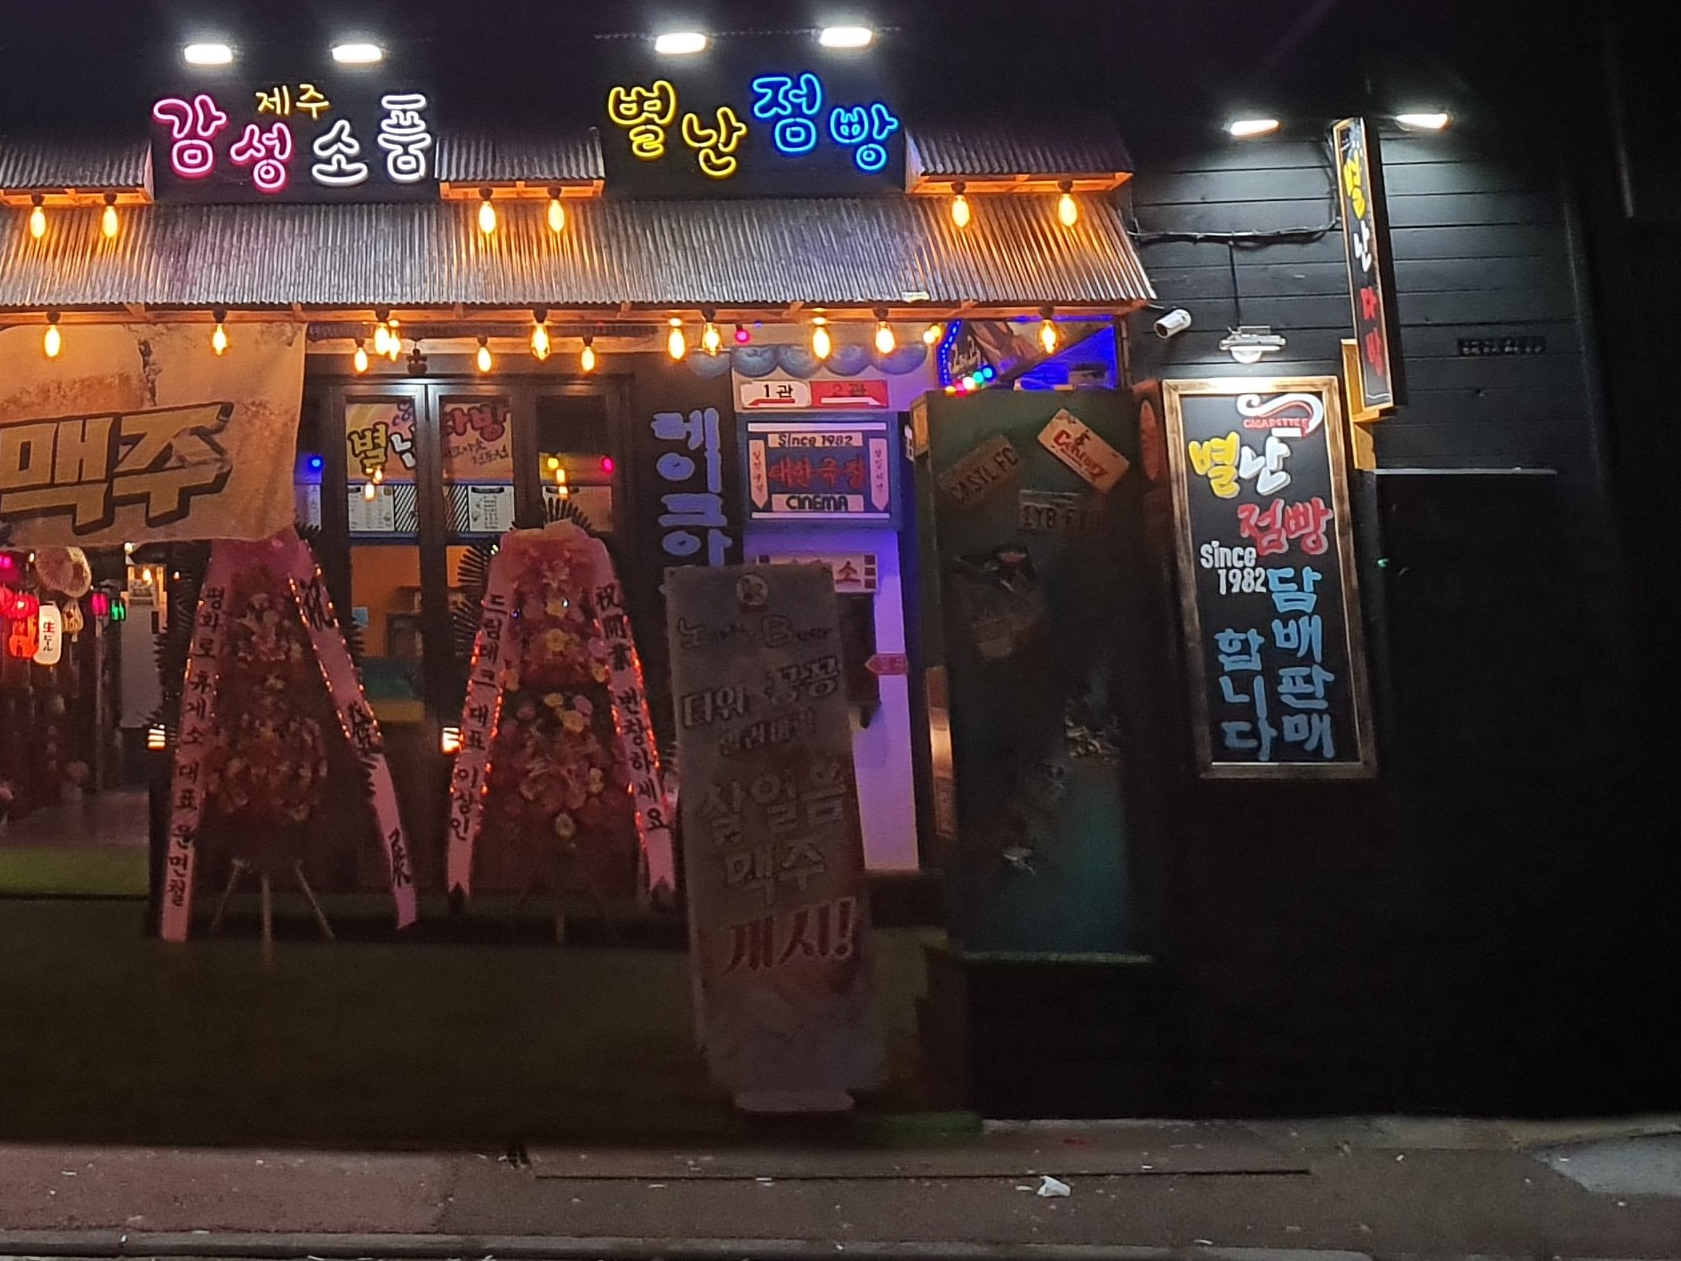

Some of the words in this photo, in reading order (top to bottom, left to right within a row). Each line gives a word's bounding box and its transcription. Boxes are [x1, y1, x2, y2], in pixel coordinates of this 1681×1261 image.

[254, 84, 329, 120] 제주
[607, 79, 749, 178] 별난
[151, 94, 294, 193] 감성
[311, 93, 433, 186] 소품
[777, 433, 817, 448] Since
[821, 434, 854, 447] 1982
[1188, 430, 1292, 499] 별난
[650, 406, 734, 568] 테이크아
[785, 494, 850, 512] CINEMA
[1200, 540, 1258, 569] Since
[1237, 496, 1335, 556] 점빵
[1217, 567, 1268, 596] 1982
[194, 586, 225, 660] 평화로
[182, 672, 213, 746] 휴게소
[1213, 627, 1279, 762] 합니다
[466, 704, 489, 750] 대표
[174, 760, 201, 812] 대표
[615, 688, 670, 832] 번창하세요
